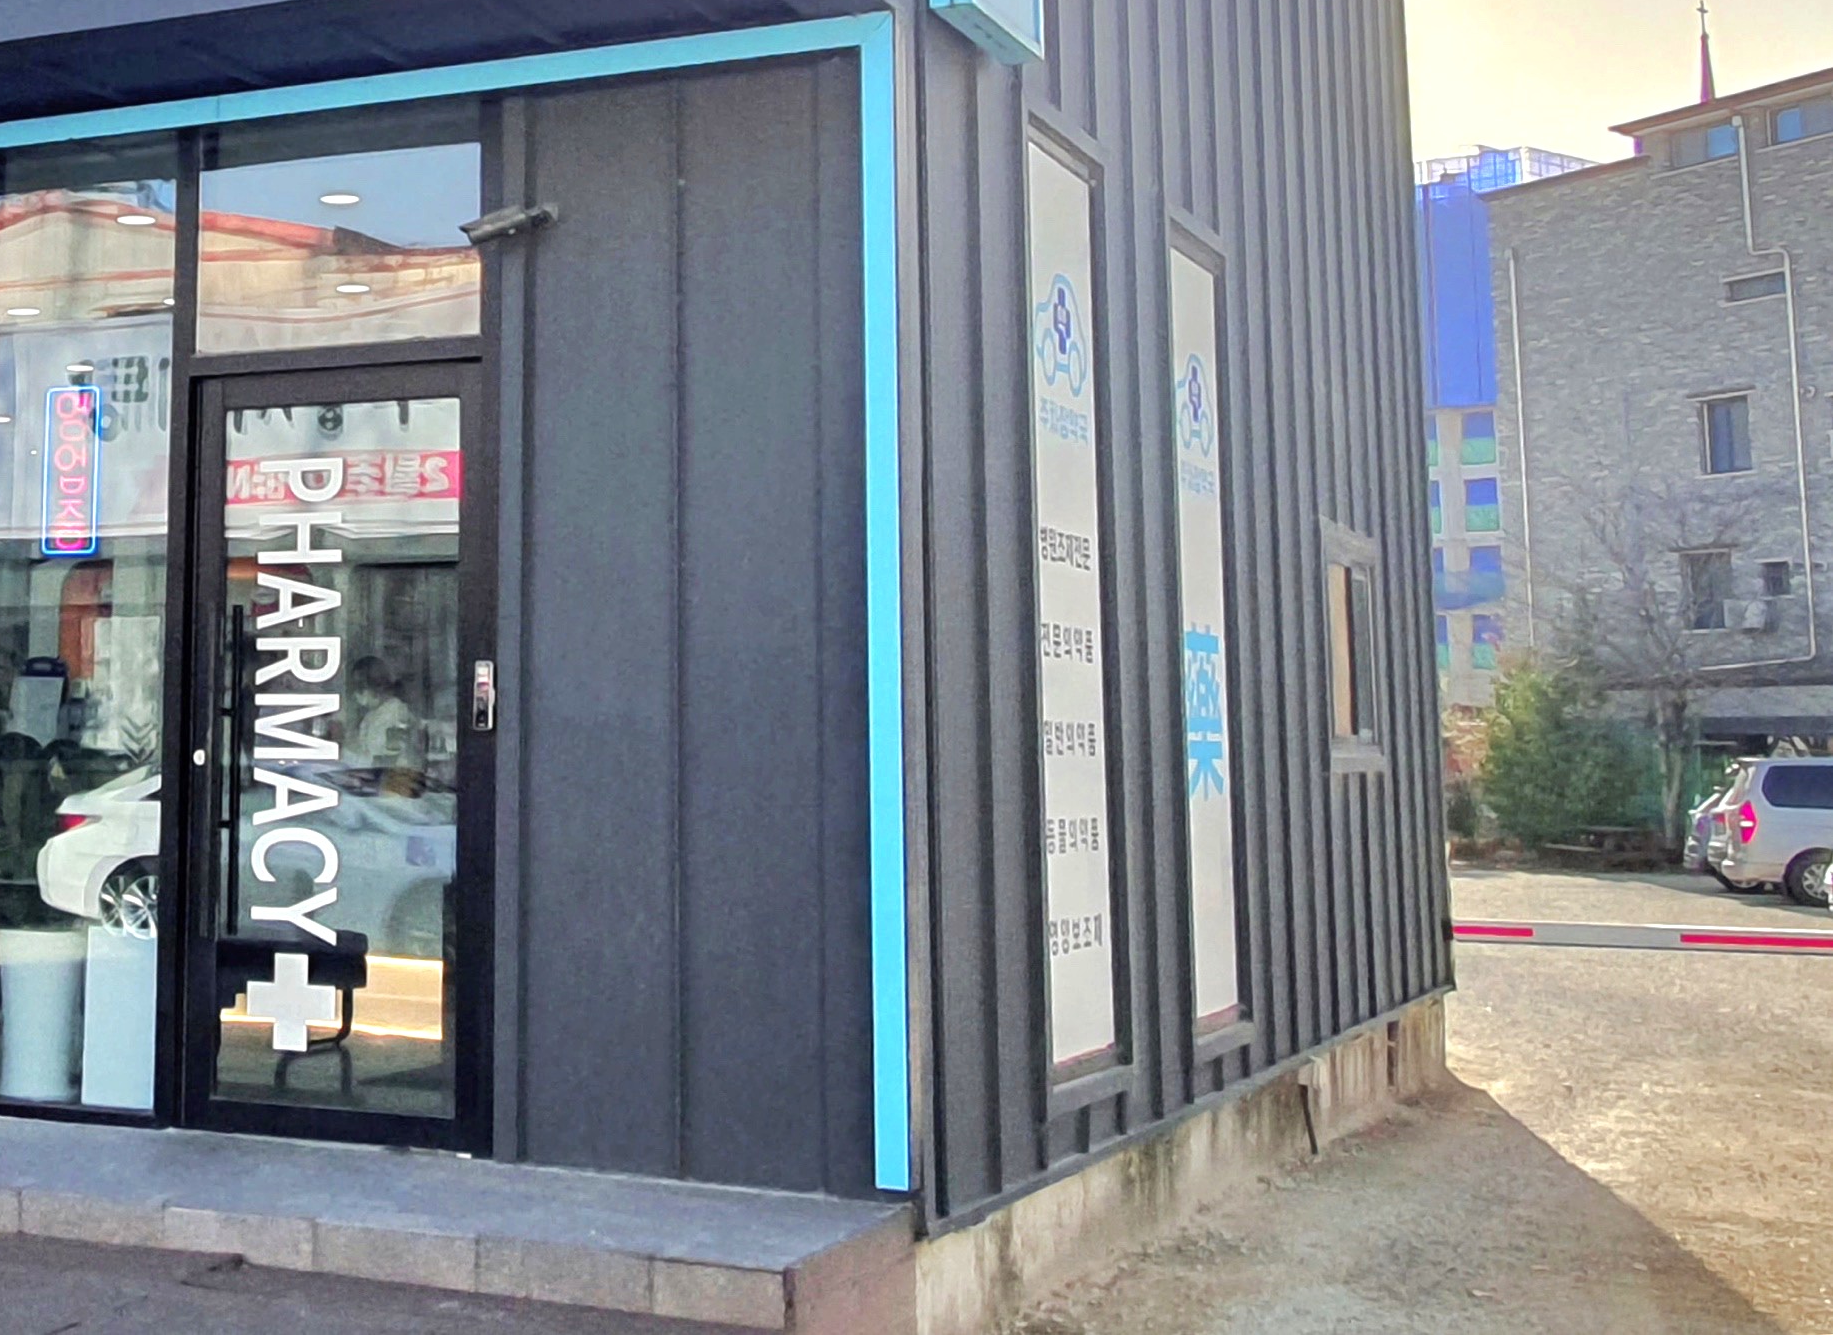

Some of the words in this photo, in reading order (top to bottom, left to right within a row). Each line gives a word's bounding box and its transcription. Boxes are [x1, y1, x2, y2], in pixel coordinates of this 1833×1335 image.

[1041, 622, 1094, 664] 전문의약품
[250, 457, 344, 947] PHARMACY
[1043, 719, 1096, 757] 일반의약품
